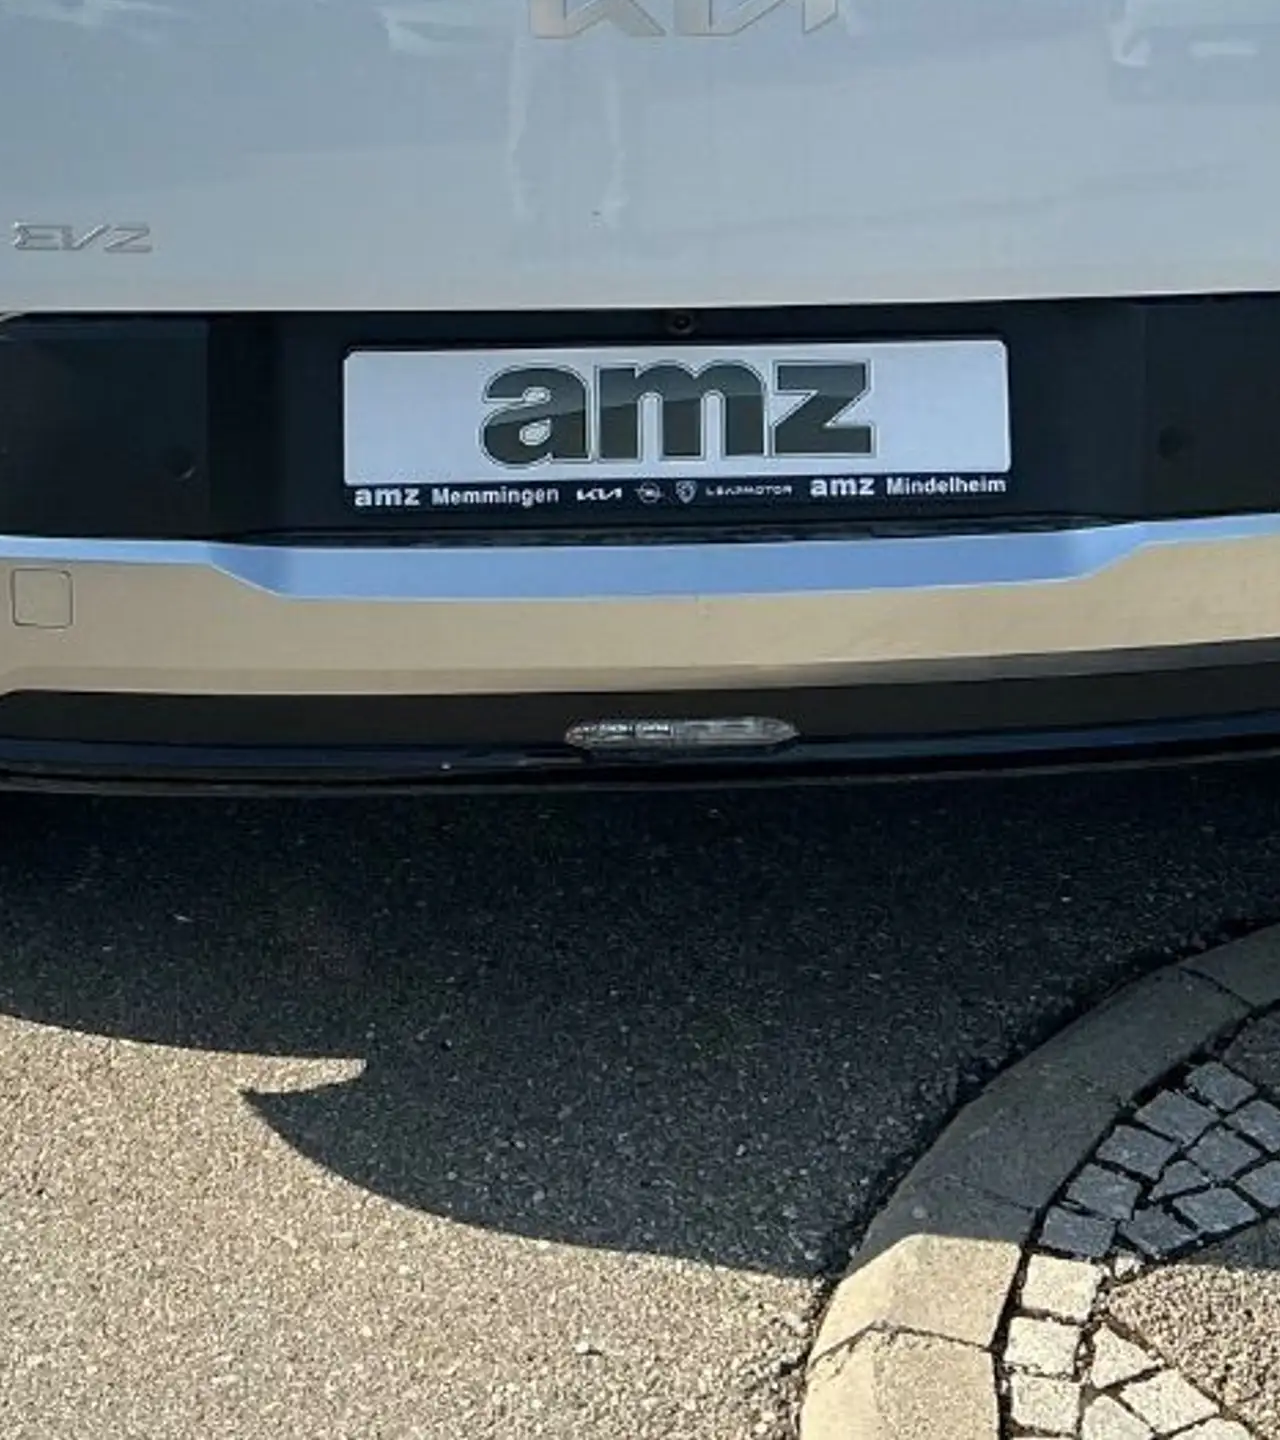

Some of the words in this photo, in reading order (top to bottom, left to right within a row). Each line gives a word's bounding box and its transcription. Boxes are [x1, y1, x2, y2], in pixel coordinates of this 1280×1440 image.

[480, 359, 876, 468] amz
[354, 488, 420, 507] amz
[431, 486, 559, 508] Memmingen
[809, 477, 875, 497] amz
[886, 474, 1007, 496] Mindelheim
